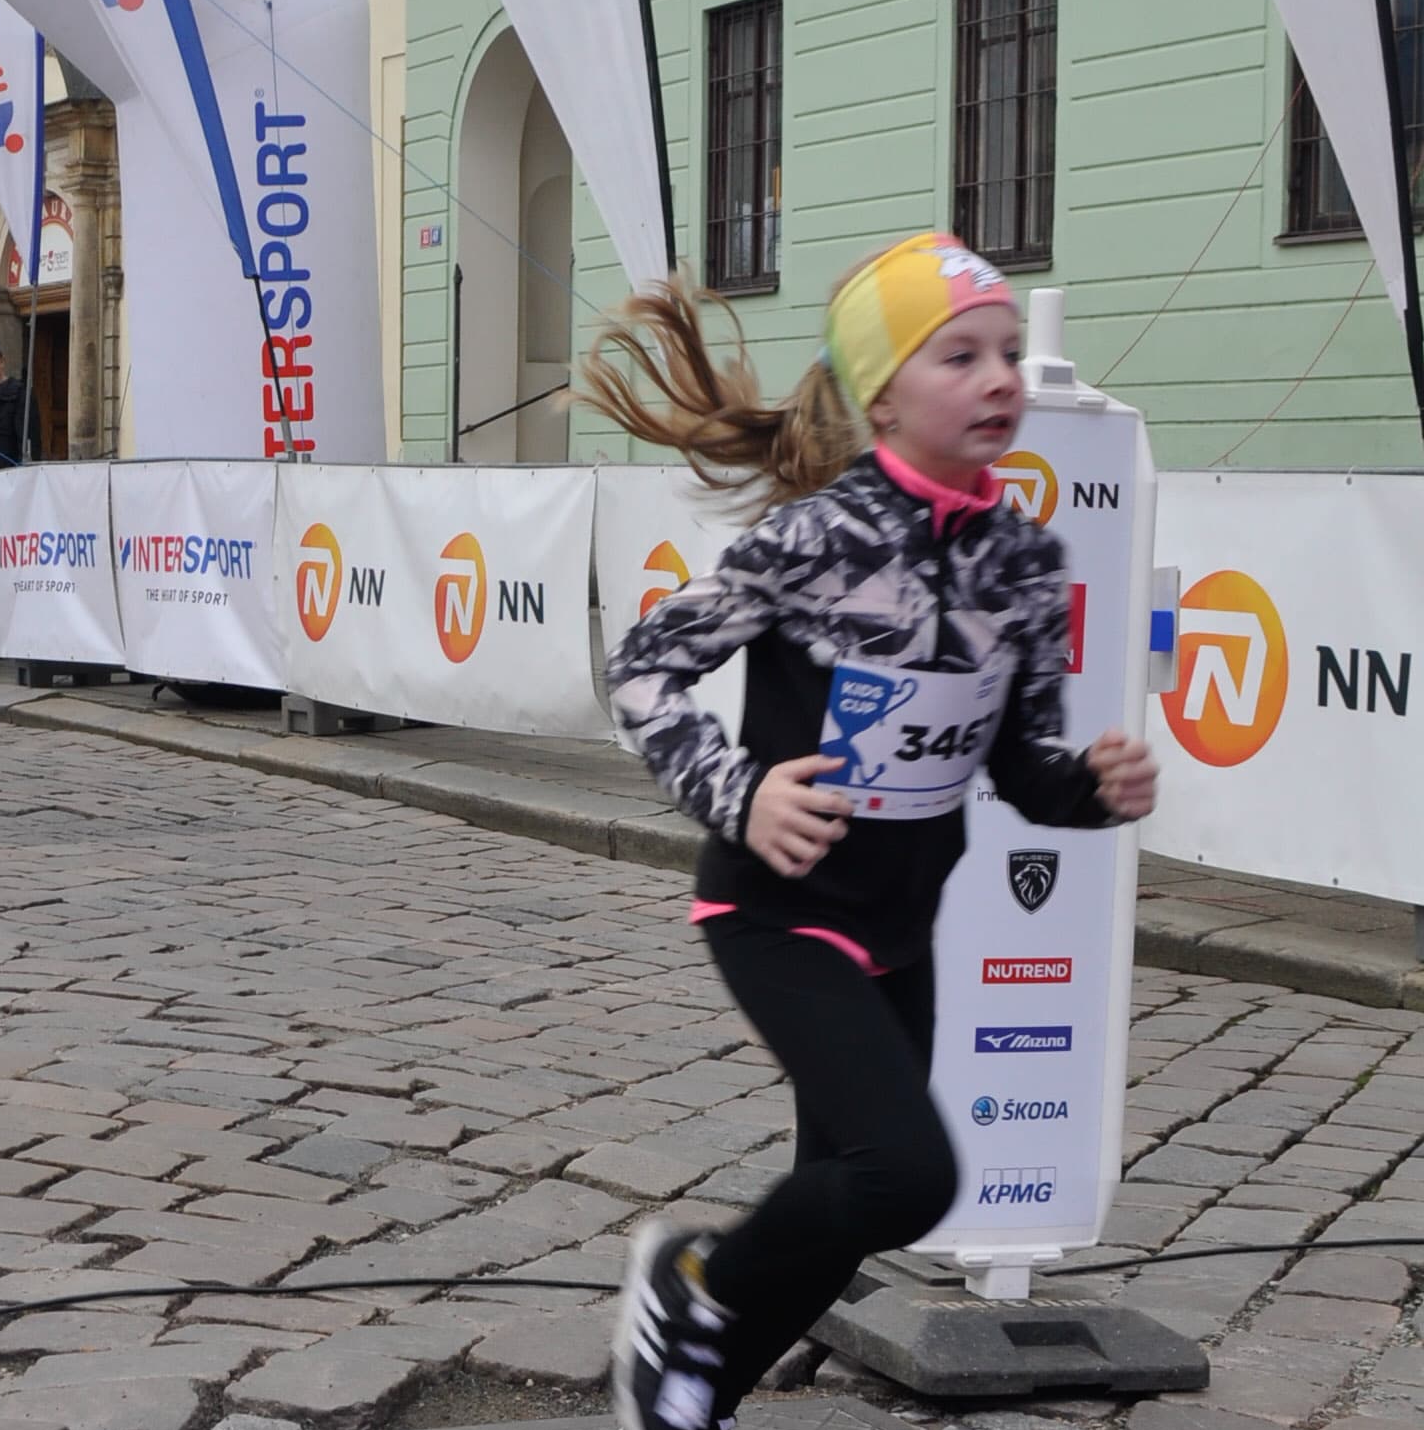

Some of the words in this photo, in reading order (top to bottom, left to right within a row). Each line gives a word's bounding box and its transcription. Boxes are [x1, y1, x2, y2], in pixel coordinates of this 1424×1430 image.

[255, 101, 316, 459] TERSPORT
[1072, 482, 1120, 510] NN
[0, 531, 98, 569] INTERSPORT
[132, 535, 253, 580] INTERSPORT
[179, 589, 190, 603] OF
[191, 589, 229, 606] SPORT
[349, 566, 385, 607] NN
[498, 579, 544, 624] NN
[1317, 645, 1412, 716] NN
[987, 962, 1069, 979] NUTREND
[1001, 1099, 1068, 1121] ŠKODA
[978, 1182, 1053, 1205] KPMG
